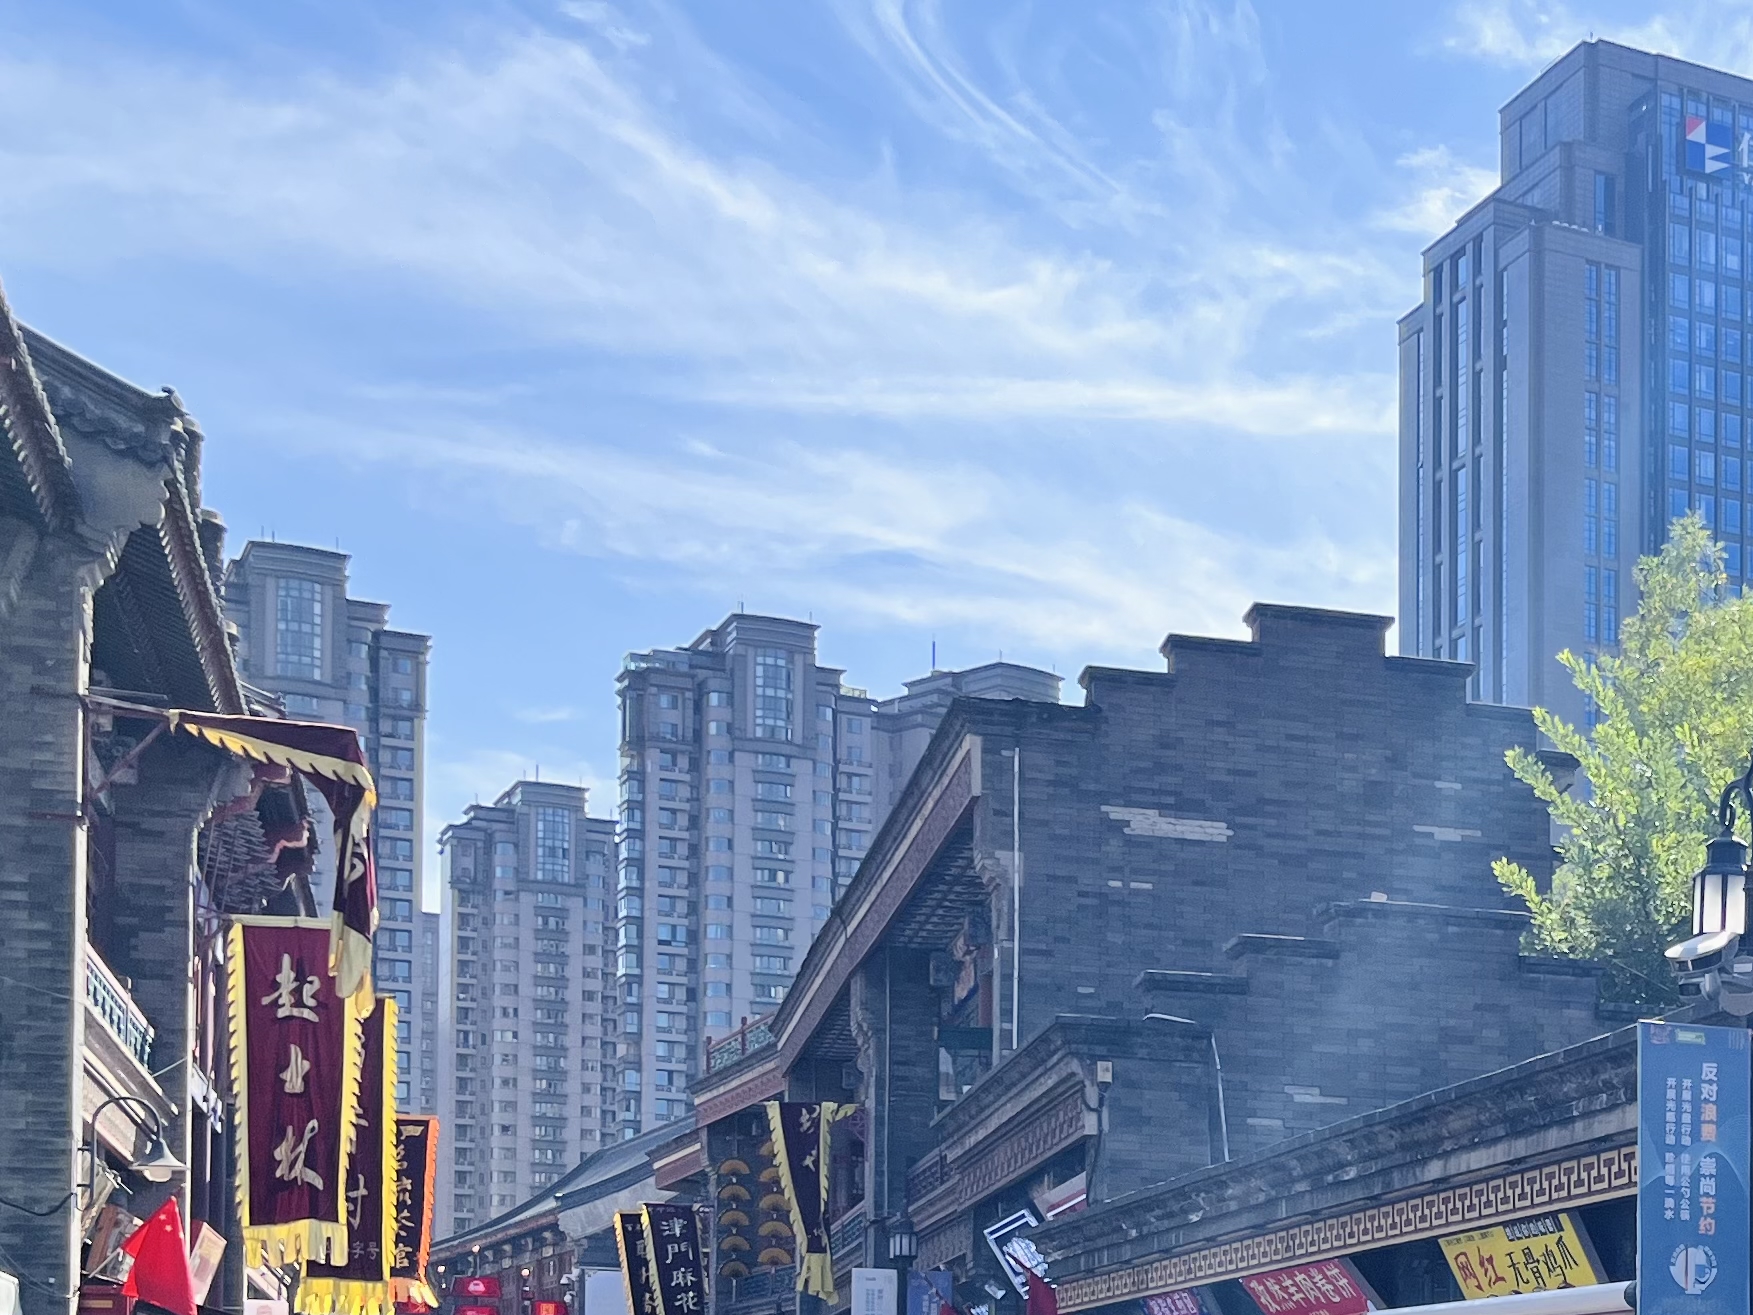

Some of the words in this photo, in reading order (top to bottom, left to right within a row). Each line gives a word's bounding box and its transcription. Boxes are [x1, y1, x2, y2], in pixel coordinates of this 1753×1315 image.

[261, 952, 324, 1191] 起士林
[1701, 1063, 1718, 1142] 反对浪费
[1664, 1077, 1676, 1145] 开展光盘行动
[1680, 1078, 1692, 1146] 开展光盘行动
[1679, 1153, 1691, 1221] 使用公勺公筷
[1698, 1157, 1717, 1235] 崇尚节约
[1250, 1262, 1357, 1314] 孜然羊肉卷饼
[1453, 1245, 1507, 1292] 网红
[1505, 1235, 1579, 1289] 无骨鸡爪
